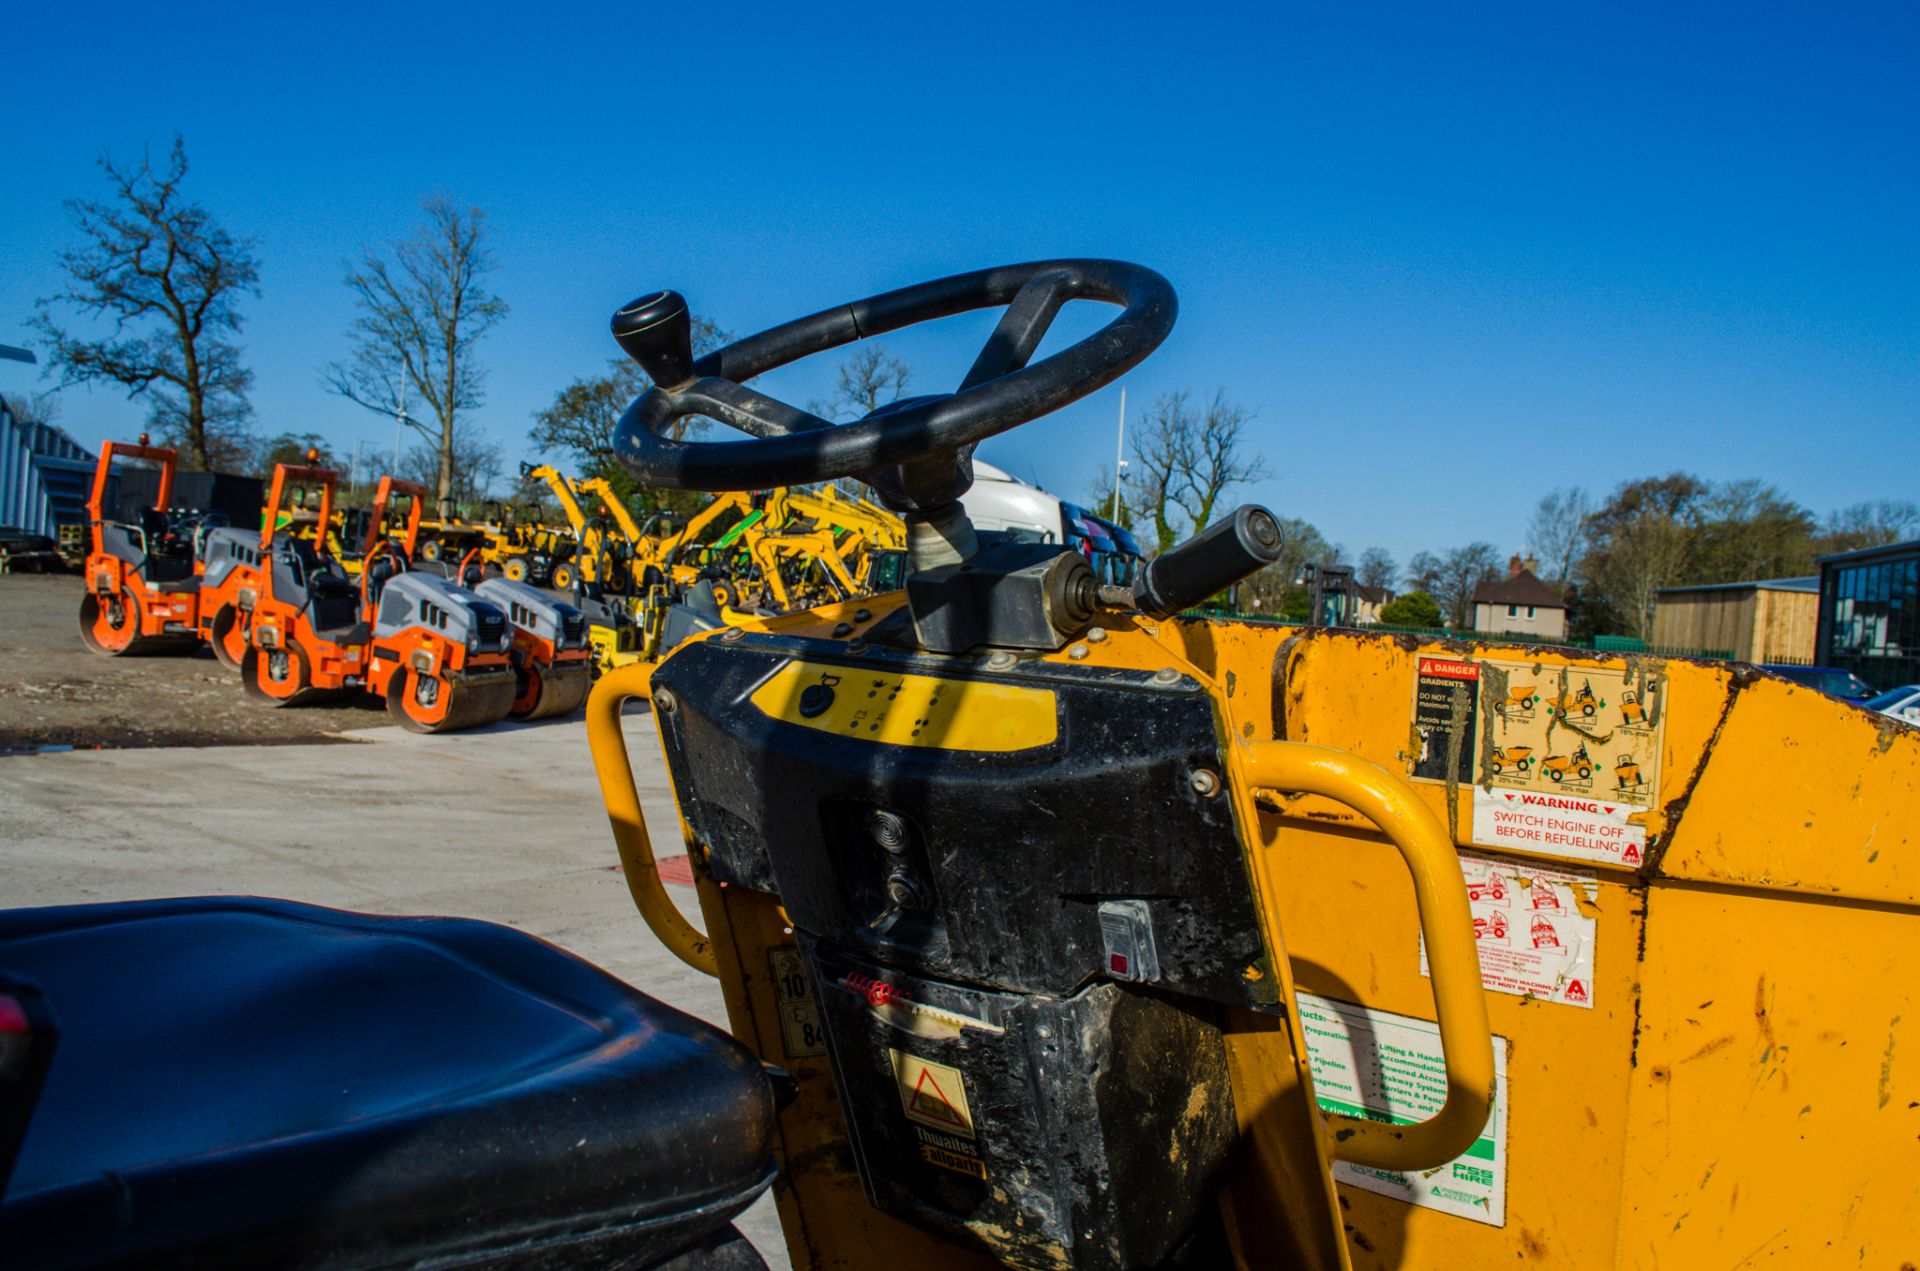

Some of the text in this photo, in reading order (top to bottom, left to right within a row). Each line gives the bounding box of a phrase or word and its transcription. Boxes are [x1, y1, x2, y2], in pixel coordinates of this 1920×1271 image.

[1434, 663, 1476, 676] DANGER
[1419, 692, 1430, 700] DO
[1418, 701, 1450, 710] maximum
[1522, 794, 1598, 814] WARNING
[1494, 811, 1625, 839] SWITCH ENGINE OFF
[1496, 825, 1620, 853] BEFORE REFUELLING
[1623, 843, 1640, 859] A
[1621, 856, 1642, 865] PLANT
[1567, 979, 1586, 996] A
[1564, 992, 1589, 1003] PLANT
[1304, 1025, 1351, 1042] Preparation
[1379, 1043, 1406, 1057] Lifting
[1314, 1056, 1346, 1070] Pipeline
[1380, 1063, 1447, 1086] Powered Access
[1380, 1073, 1448, 1095] Trakway System
[1380, 1083, 1413, 1097] Barriers
[1417, 1104, 1434, 1113] and
[913, 1125, 978, 1157] Thwaites
[1453, 1163, 1494, 1180] PSS
[1453, 1172, 1494, 1187] HIRE
